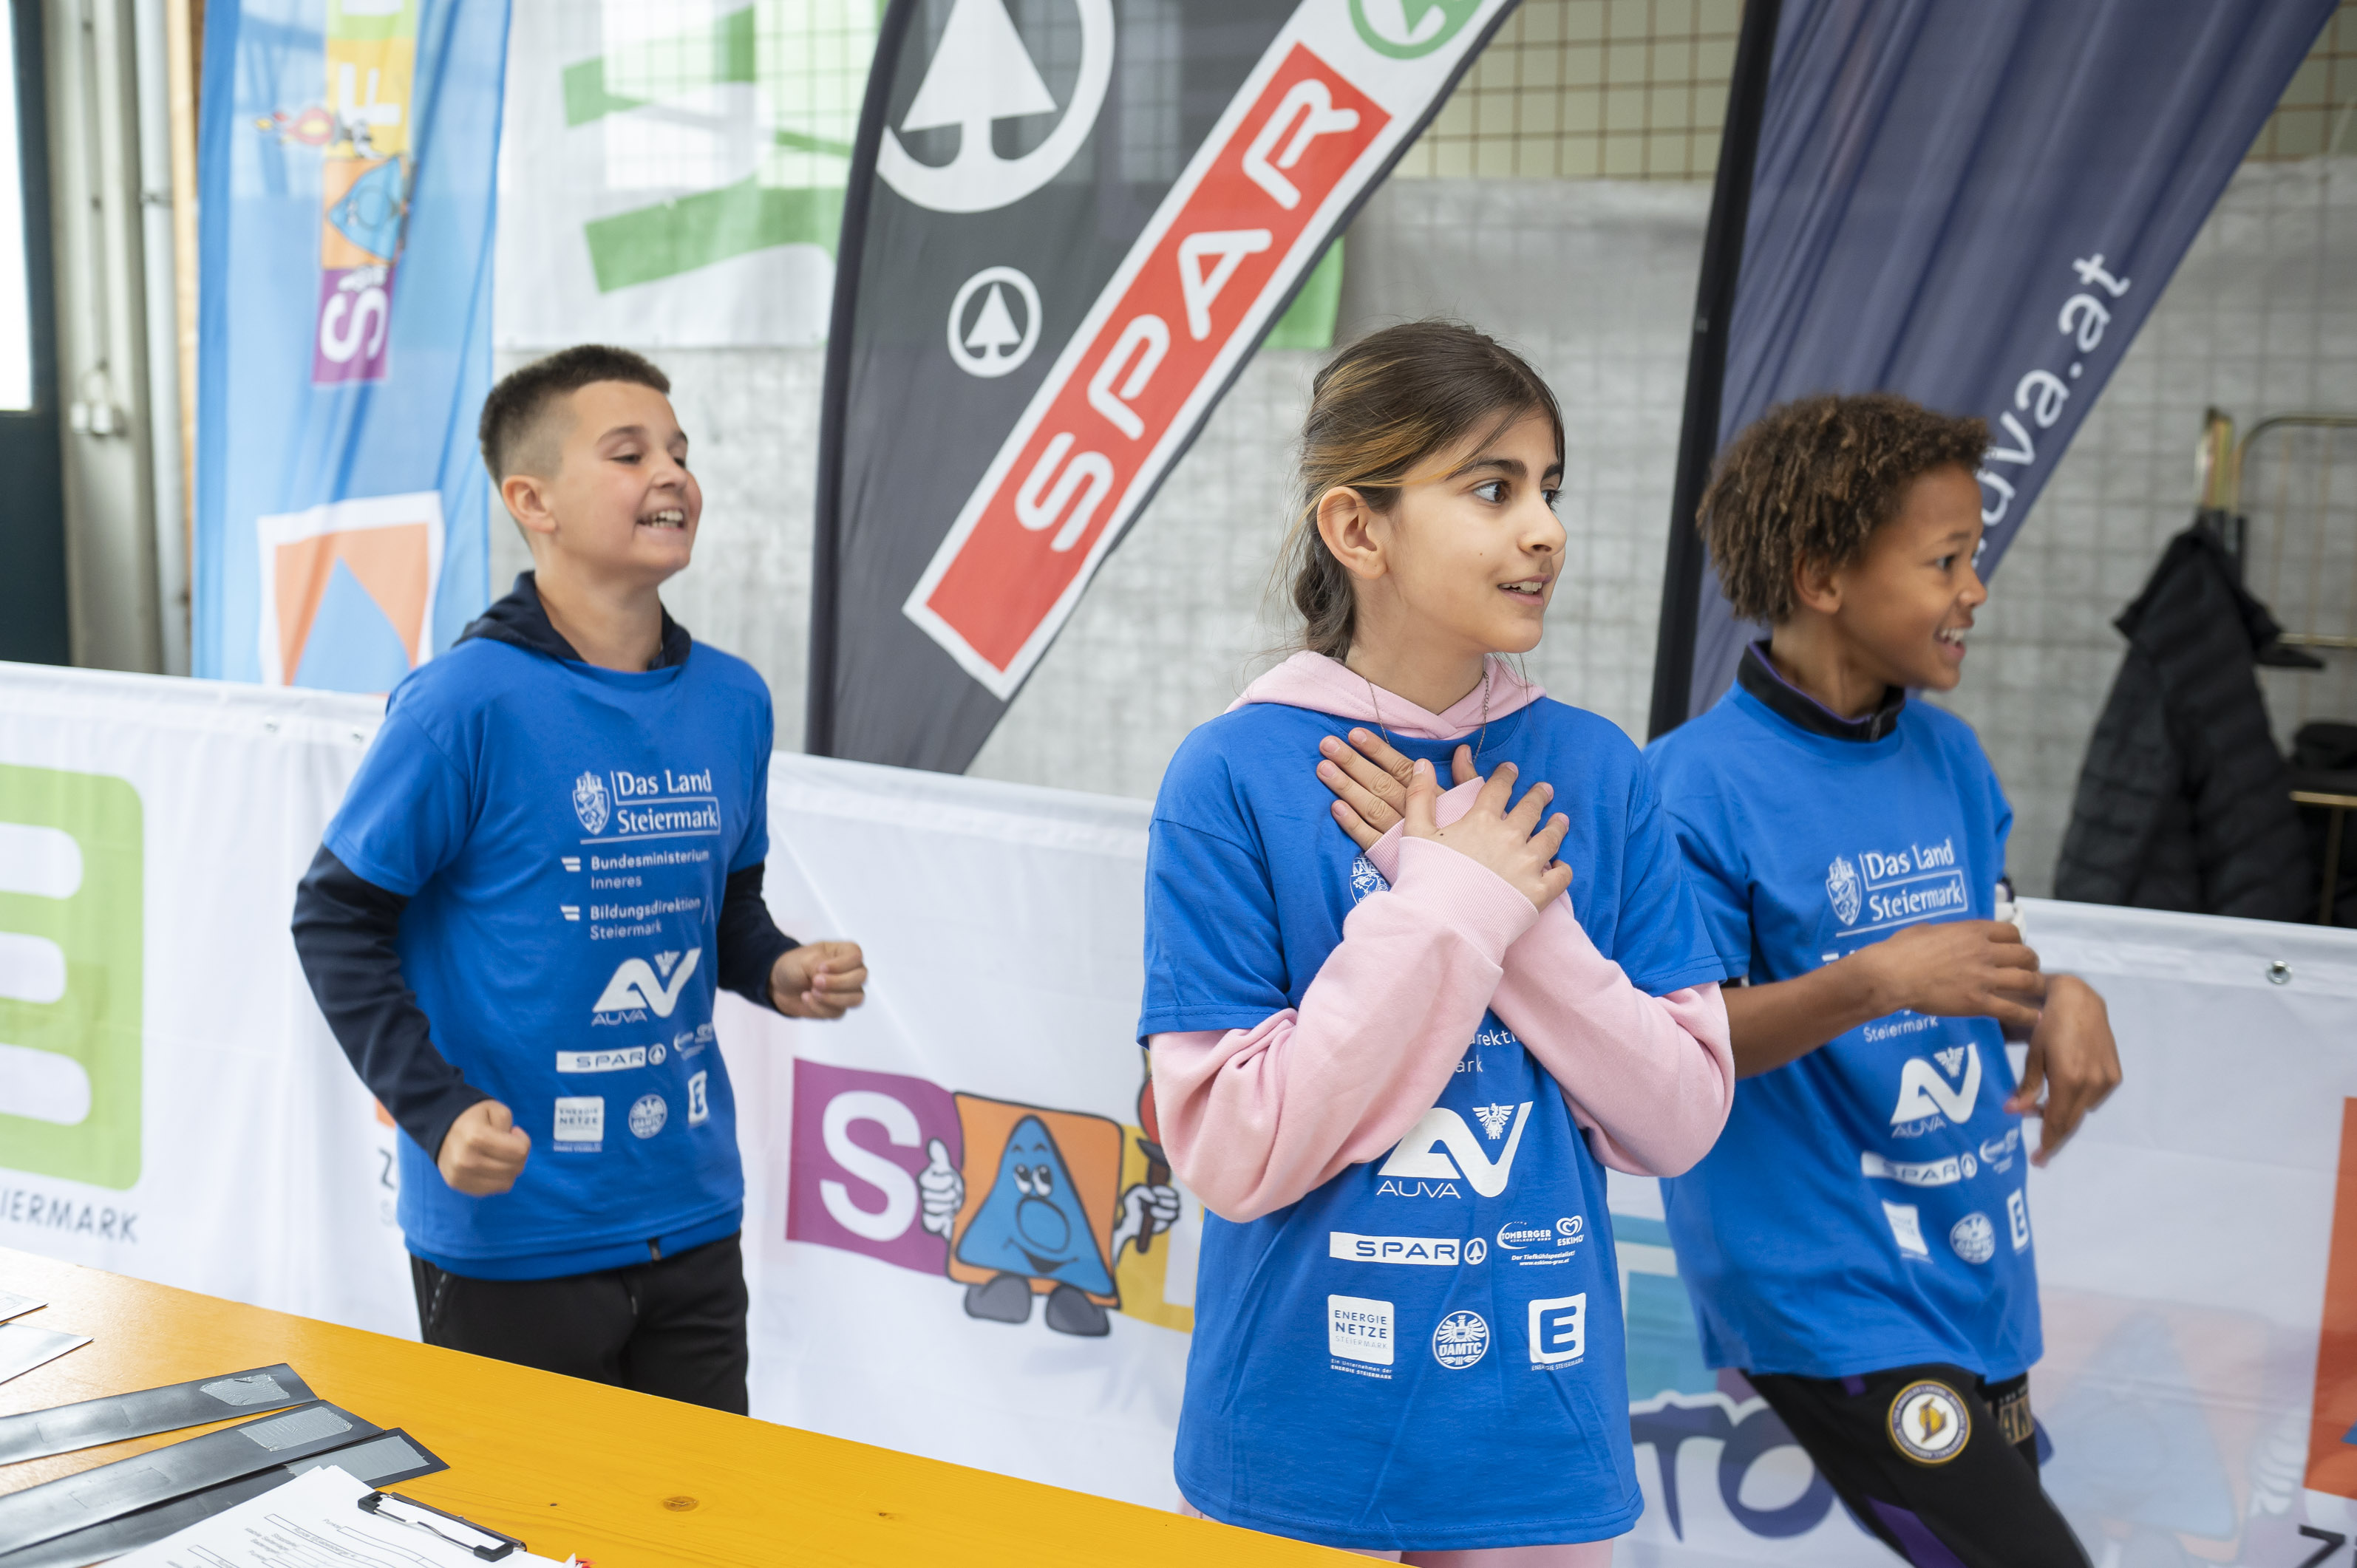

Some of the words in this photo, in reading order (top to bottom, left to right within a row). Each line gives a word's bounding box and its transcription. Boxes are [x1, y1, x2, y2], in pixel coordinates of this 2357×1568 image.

[1015, 79, 1360, 552] SPAR
[1972, 253, 2131, 569] uva.at
[616, 771, 659, 796] Das
[665, 768, 712, 793] Land
[617, 805, 718, 834] Steiermark
[1864, 853, 1911, 880] Das
[1911, 836, 1955, 870] Land
[591, 876, 642, 890] Inneres
[591, 897, 701, 921] Bildungsdirektion
[1868, 879, 1962, 922] Steiermark
[590, 918, 662, 941] Steiermark
[592, 1009, 647, 1026] AUVA
[1863, 1015, 1938, 1043] Steiermark
[577, 1051, 643, 1068] SPAR
[1892, 1116, 1945, 1139] AUVA
[1377, 1181, 1461, 1199] AUVA
[1356, 1241, 1455, 1259] SPAR
[1557, 1235, 1584, 1247] ESKIMO
[1335, 1310, 1387, 1325] ENERGIE
[1336, 1322, 1387, 1339] NETZE
[1336, 1335, 1388, 1349] STEIERMARK
[1331, 1364, 1355, 1374] ENERGIE
[1356, 1369, 1392, 1380] STEIERMARK
[1342, 1360, 1380, 1372] Unternehmen
[1555, 1357, 1584, 1371] STEIERMARK
